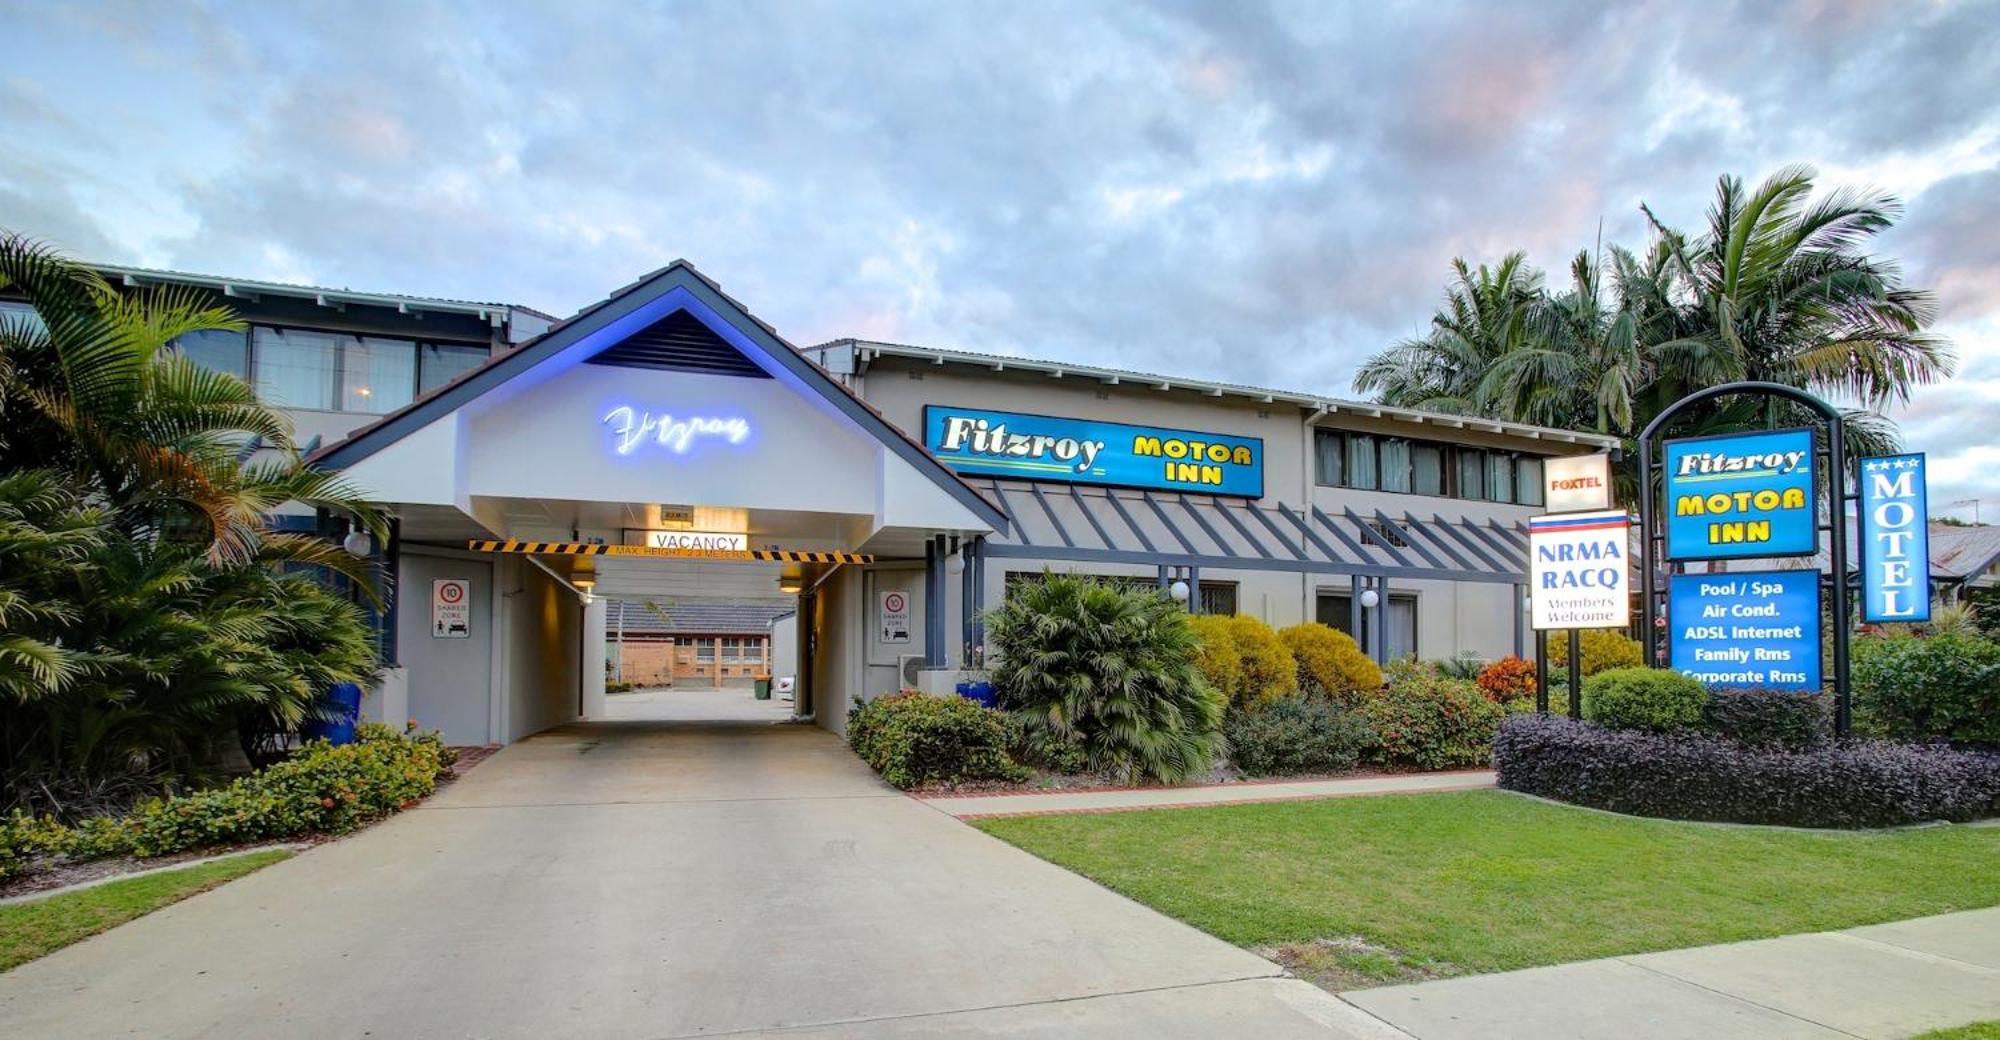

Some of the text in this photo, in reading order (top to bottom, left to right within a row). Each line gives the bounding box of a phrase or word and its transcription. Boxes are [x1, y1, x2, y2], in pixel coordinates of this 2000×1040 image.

[603, 405, 749, 454] Fitzroy
[941, 415, 1104, 471] Fitzroy
[1133, 435, 1252, 465] MOTOR
[1676, 450, 1806, 474] Fitzroy
[1164, 461, 1223, 485] INN
[1551, 477, 1602, 491] FOXTEL
[1676, 486, 1805, 517] MOTOR
[656, 534, 739, 550] VACANCY
[1708, 520, 1771, 544] INN
[1538, 540, 1621, 562] NRMA
[1869, 471, 1917, 617] MOTEL
[1542, 567, 1620, 590] RACQ
[446, 588, 457, 598] 10
[1700, 582, 1784, 598] Pool / Spa
[1549, 598, 1615, 609] Members
[1702, 602, 1780, 618] Air Cond.
[1549, 610, 1615, 623] Welcome
[1684, 625, 1802, 640] ADSL Internet
[1695, 647, 1791, 665] Family Rms
[1769, 670, 1807, 683] Rms
